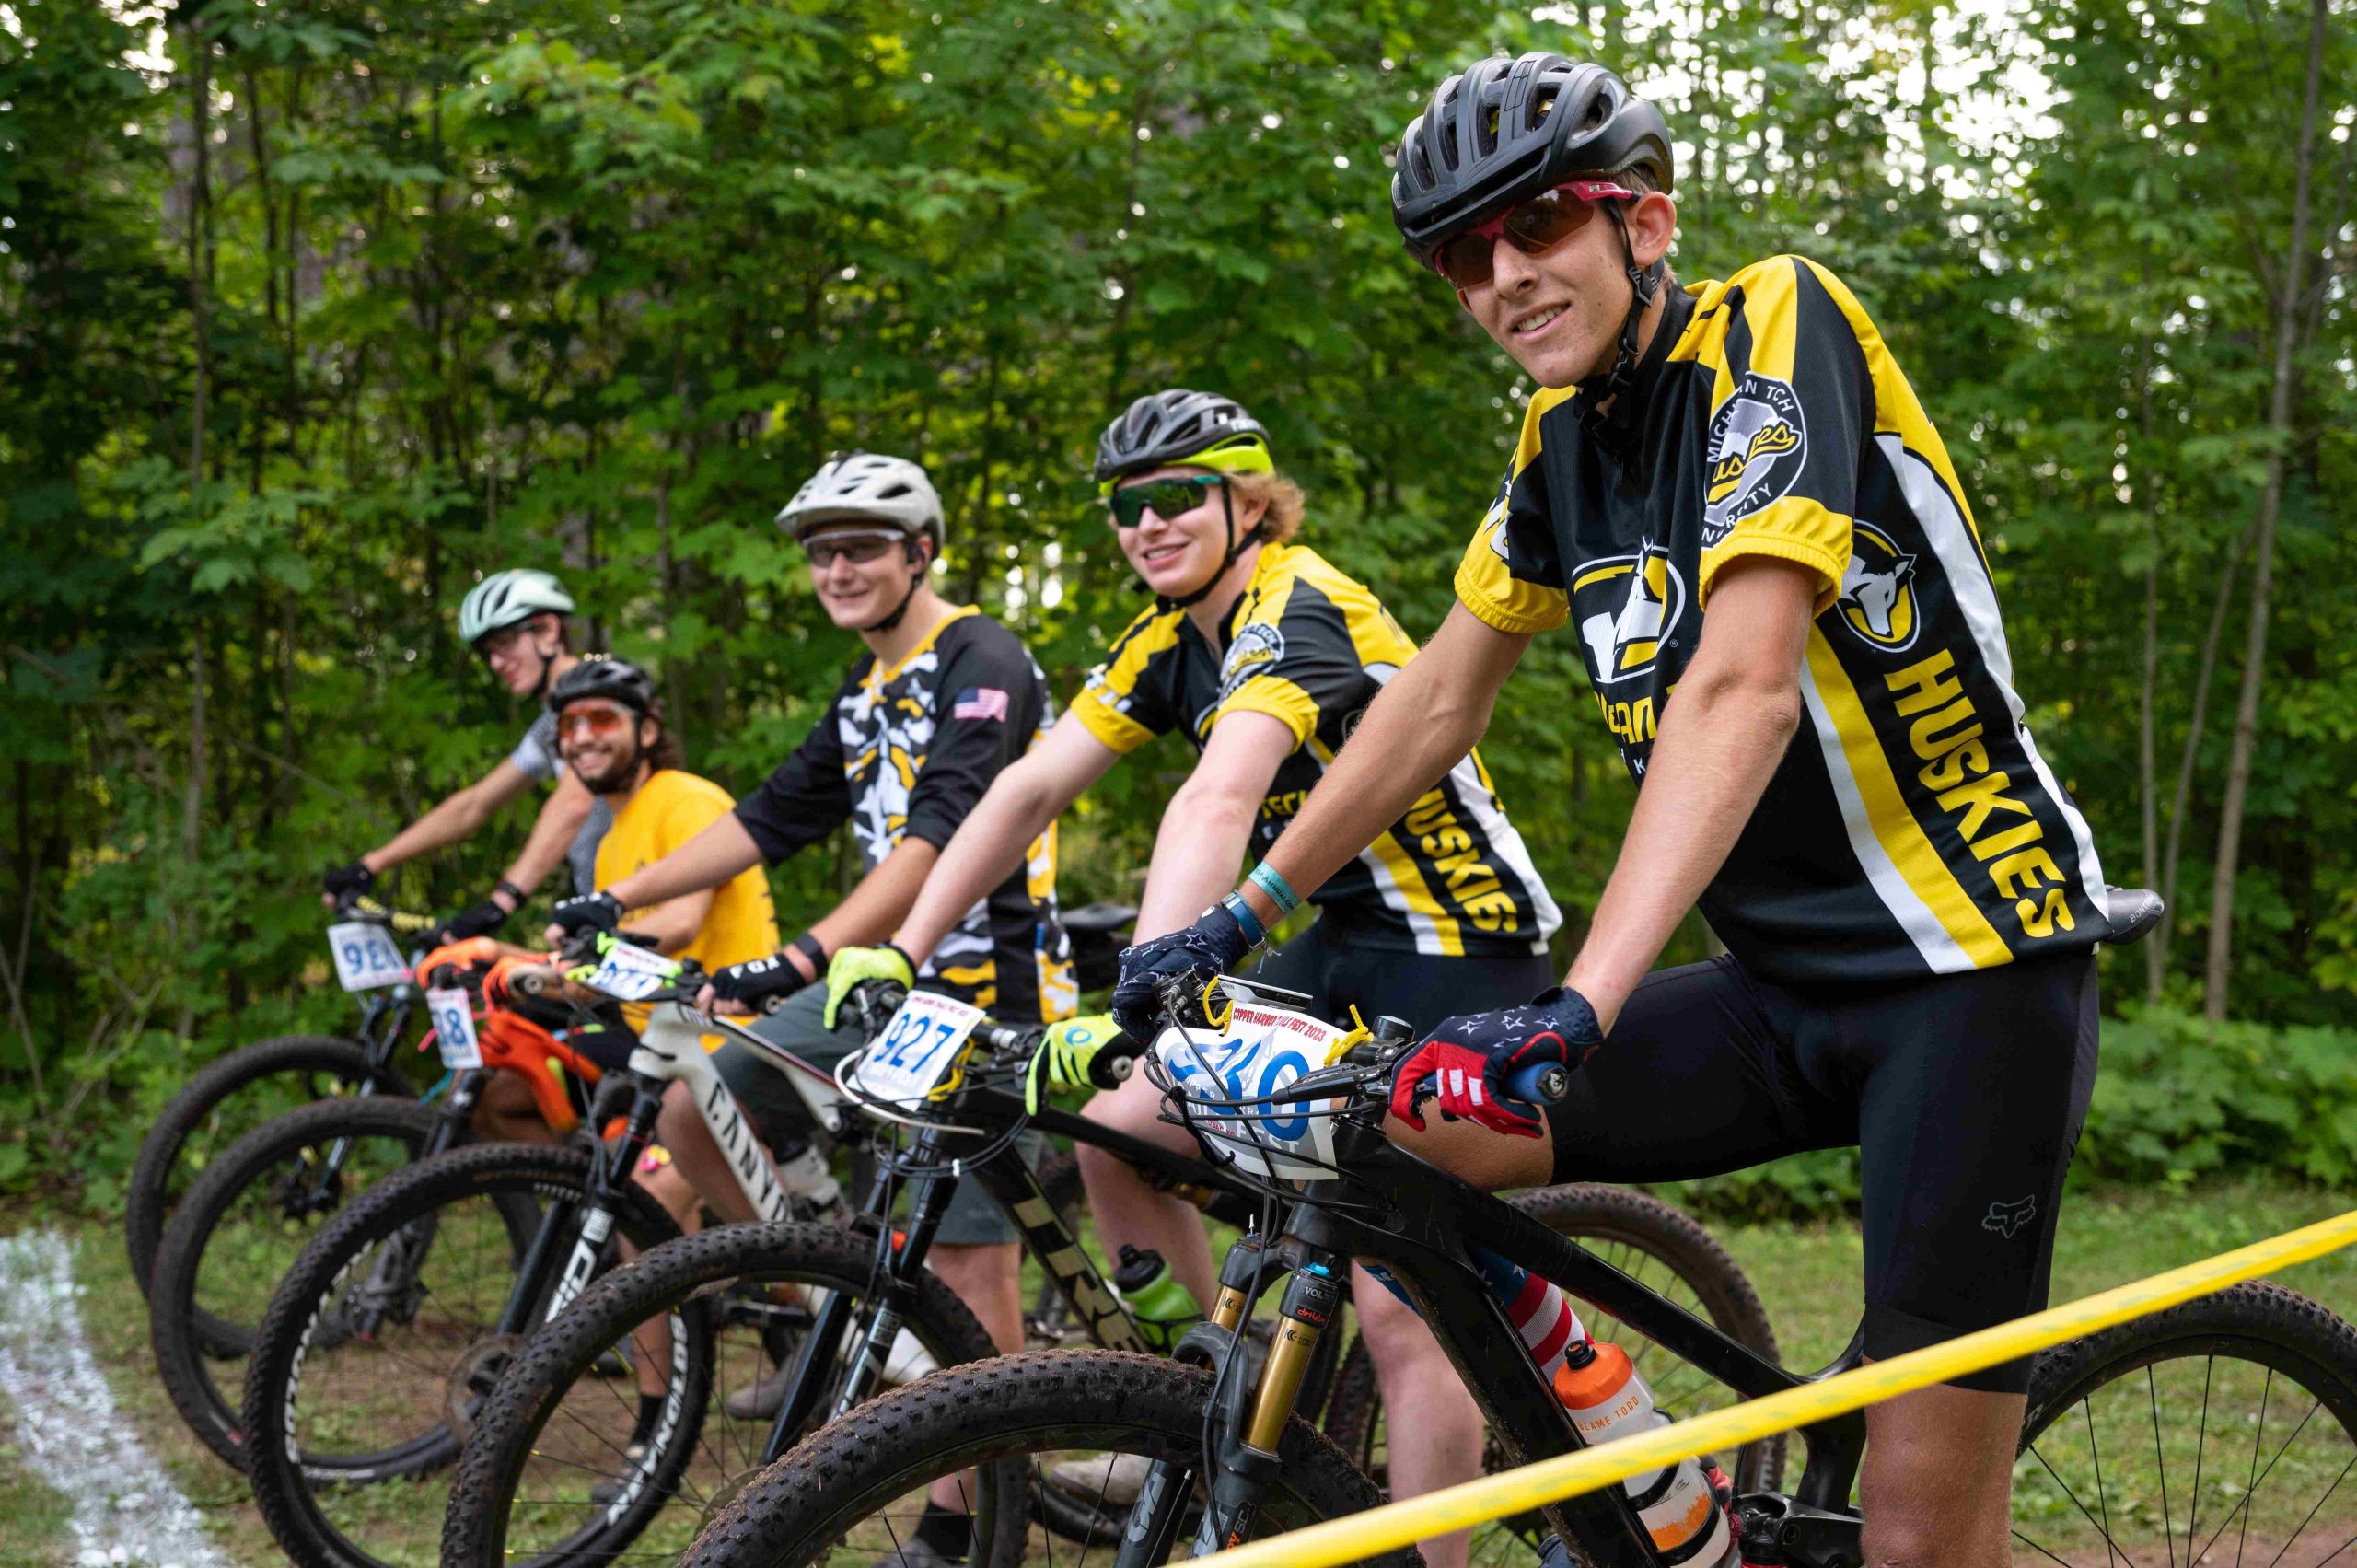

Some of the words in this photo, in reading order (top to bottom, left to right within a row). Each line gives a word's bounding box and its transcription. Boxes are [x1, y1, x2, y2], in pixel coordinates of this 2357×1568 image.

[1883, 648, 2075, 938] HUSKIES
[874, 1013, 956, 1074] 927
[1290, 1017, 1308, 1033] FEST
[1304, 1025, 1327, 1042] 2023
[1014, 1171, 1151, 1355] TRE
[1577, 1416, 1612, 1432] BLAME
[1614, 1395, 1640, 1420] TODD
